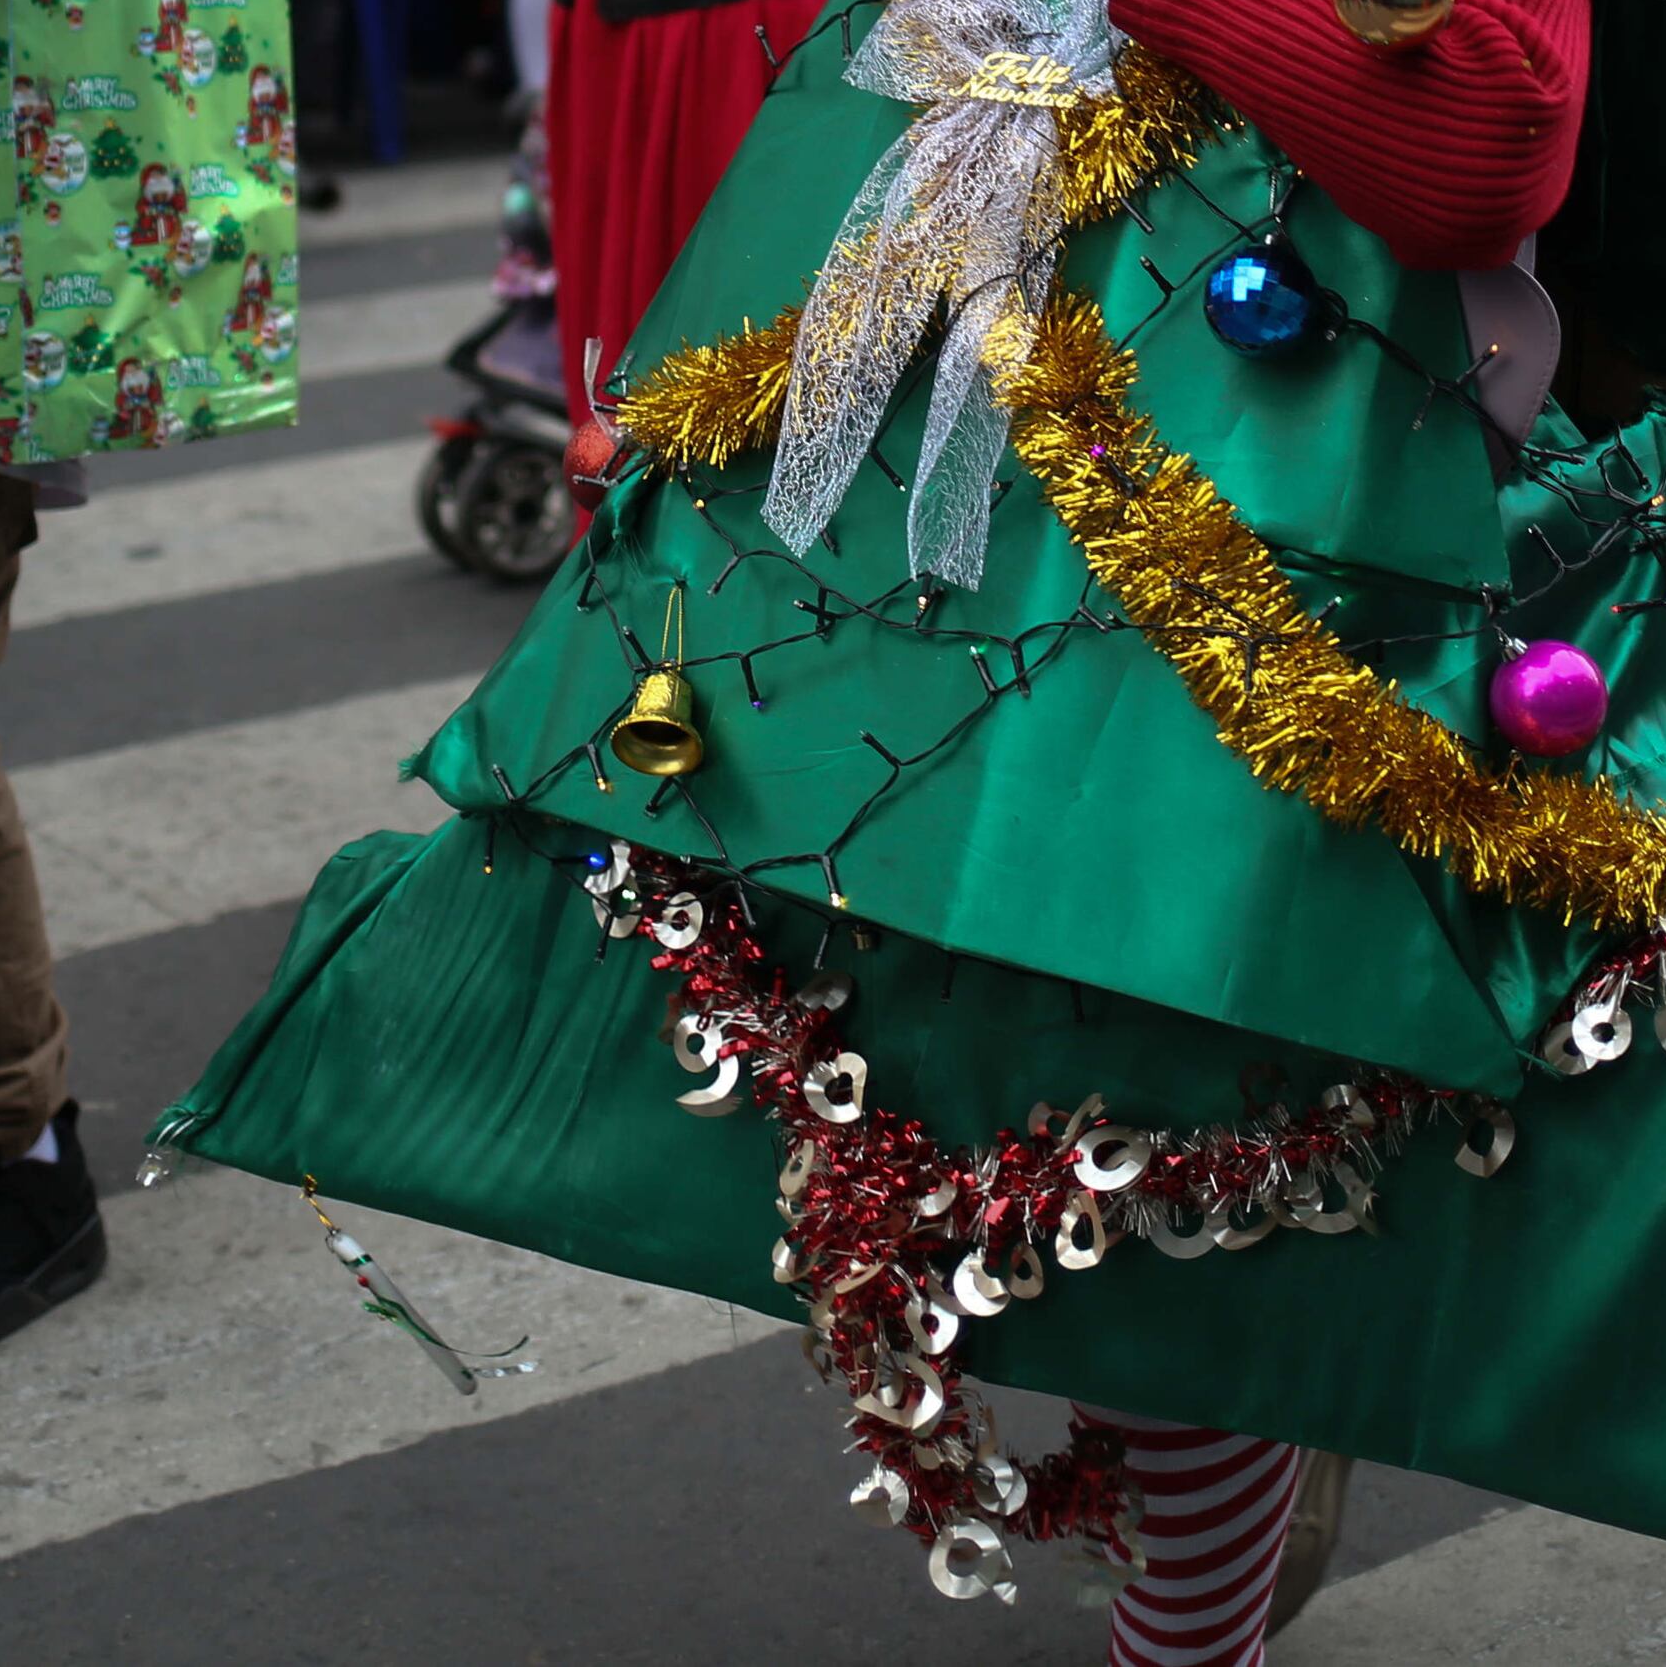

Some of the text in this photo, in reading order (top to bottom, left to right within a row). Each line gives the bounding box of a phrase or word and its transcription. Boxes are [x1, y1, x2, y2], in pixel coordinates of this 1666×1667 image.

[978, 51, 1071, 84] Feliz
[63, 90, 136, 109] CHRISTMAS
[948, 76, 1084, 108] Navidad
[40, 288, 113, 307] CHRISTMAS
